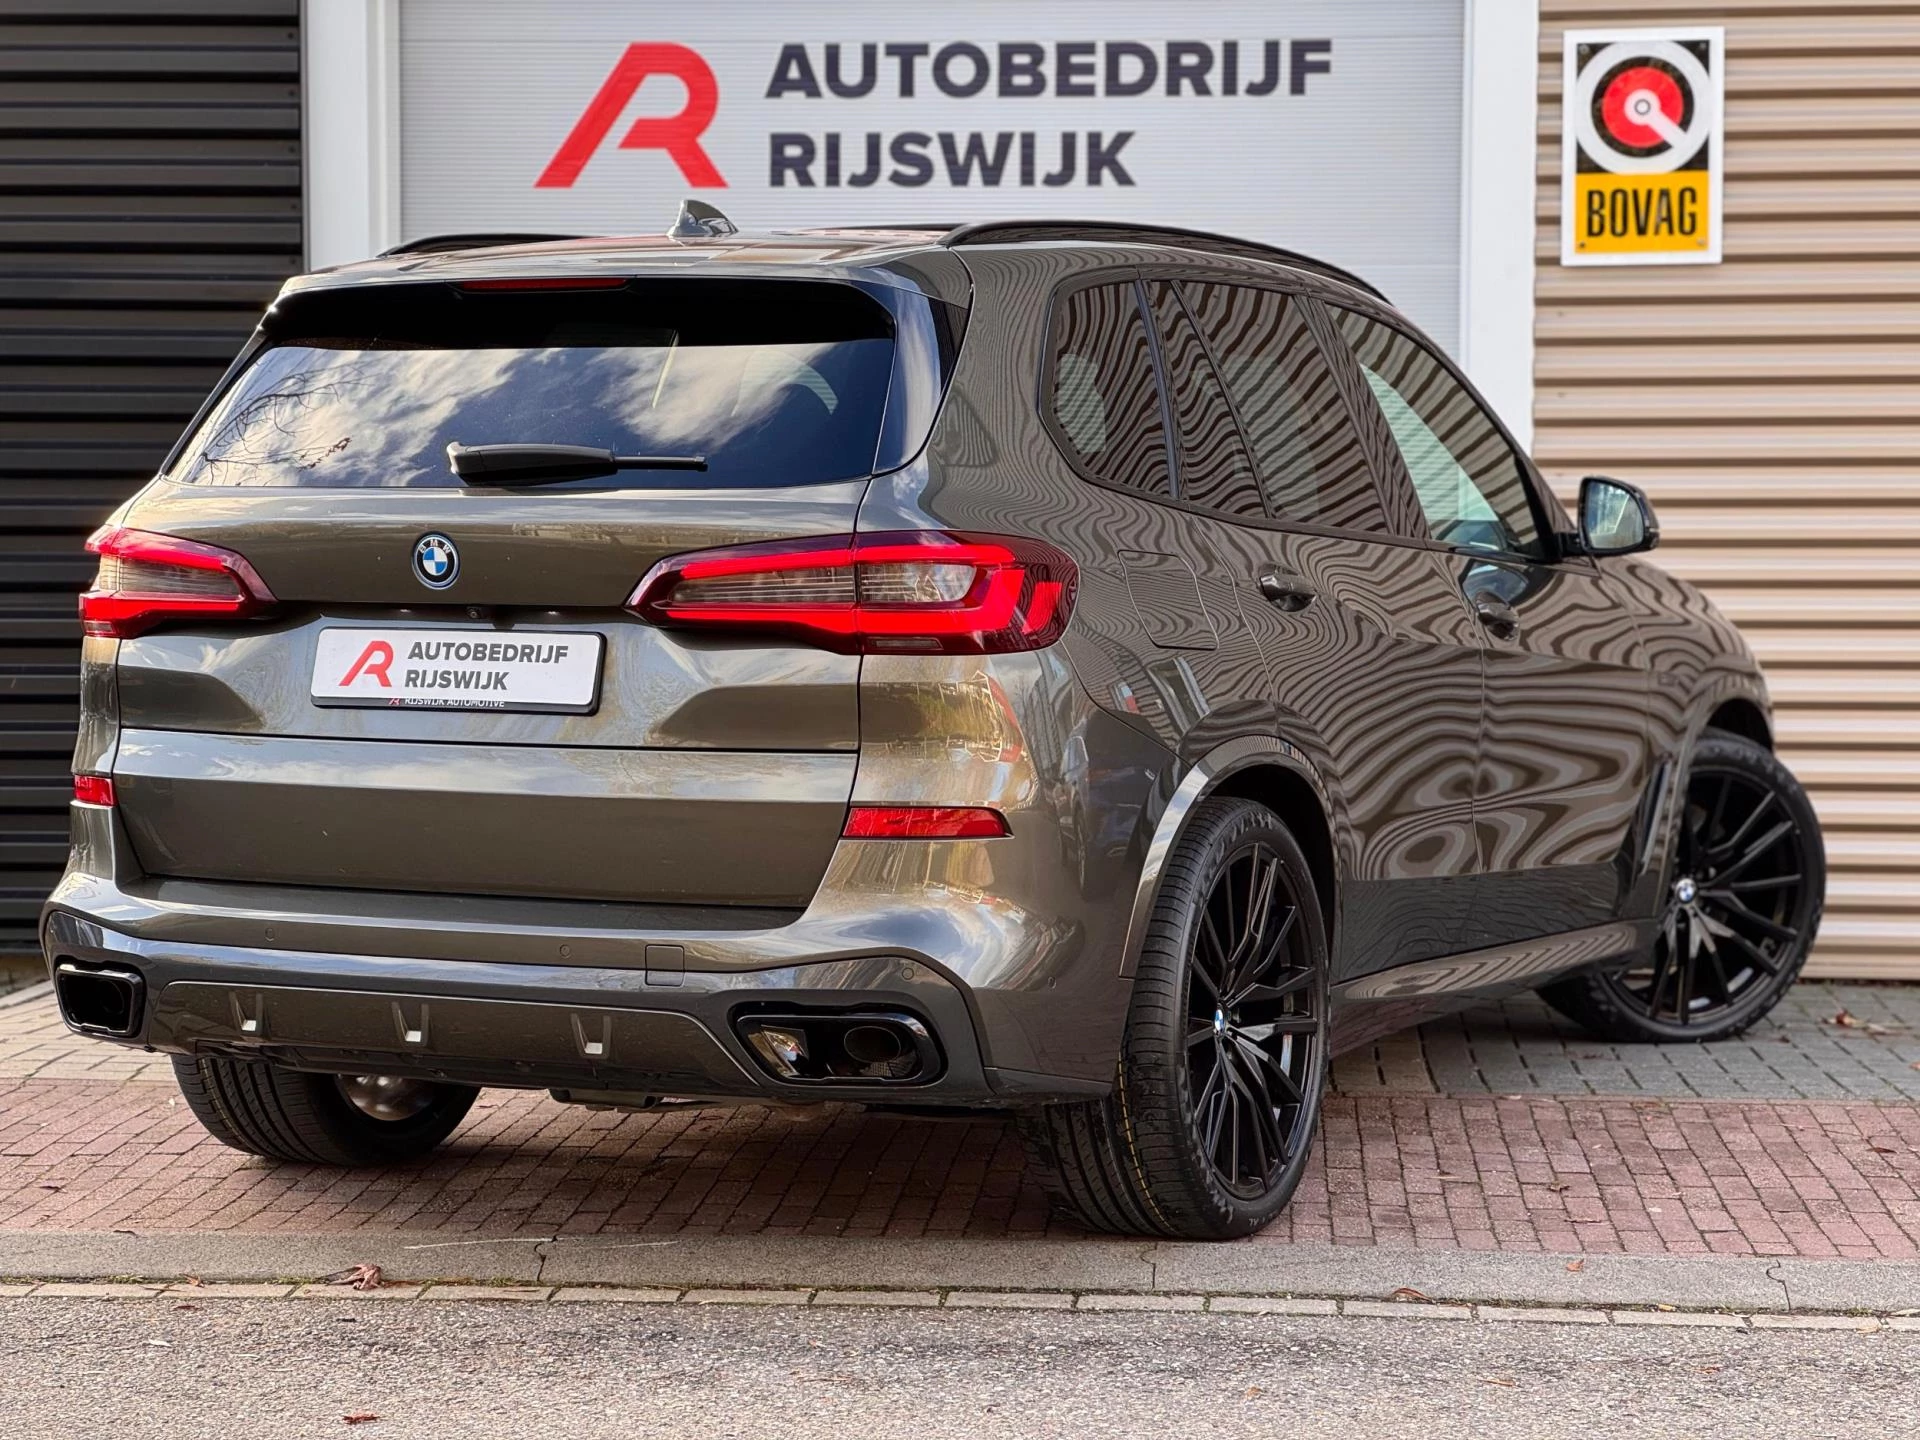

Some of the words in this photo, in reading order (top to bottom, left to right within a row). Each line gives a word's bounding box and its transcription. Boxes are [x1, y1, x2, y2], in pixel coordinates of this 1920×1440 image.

[765, 39, 1332, 99] AUTOBEDRIJF
[769, 131, 1136, 188] RIJSWIJK
[1586, 187, 1697, 238] BOVAG
[418, 539, 451, 554] BMW
[407, 641, 569, 664] AUTOBEDRIJF
[404, 669, 510, 691] RIJSWIJK
